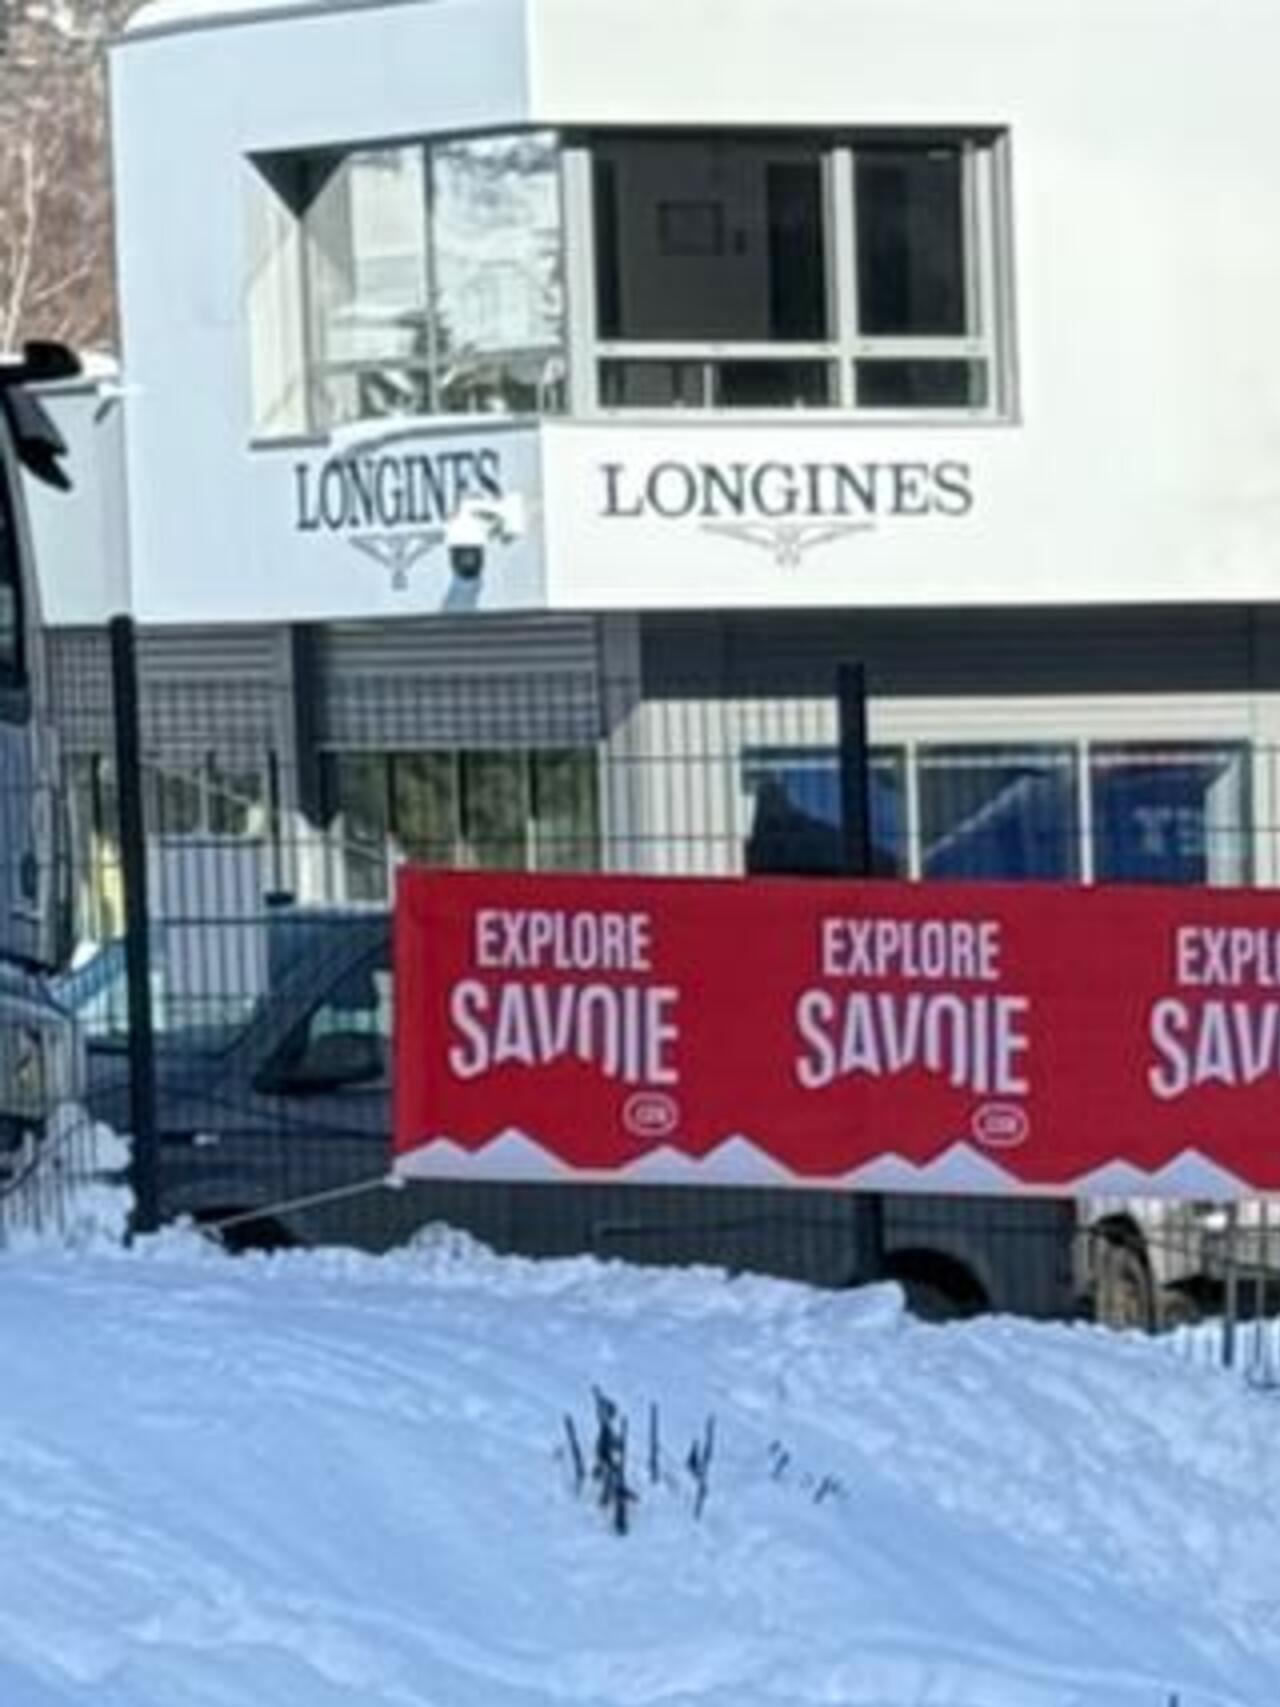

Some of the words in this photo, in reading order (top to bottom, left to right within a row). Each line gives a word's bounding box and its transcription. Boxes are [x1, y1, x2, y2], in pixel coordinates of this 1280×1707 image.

[294, 448, 502, 530] LONGINES
[598, 460, 974, 519] LONGINES
[475, 908, 653, 971] EXPLORE
[822, 918, 1000, 981] EXPLORE
[448, 978, 680, 1086] SAVOIE
[795, 989, 1030, 1096] SAVOIE
